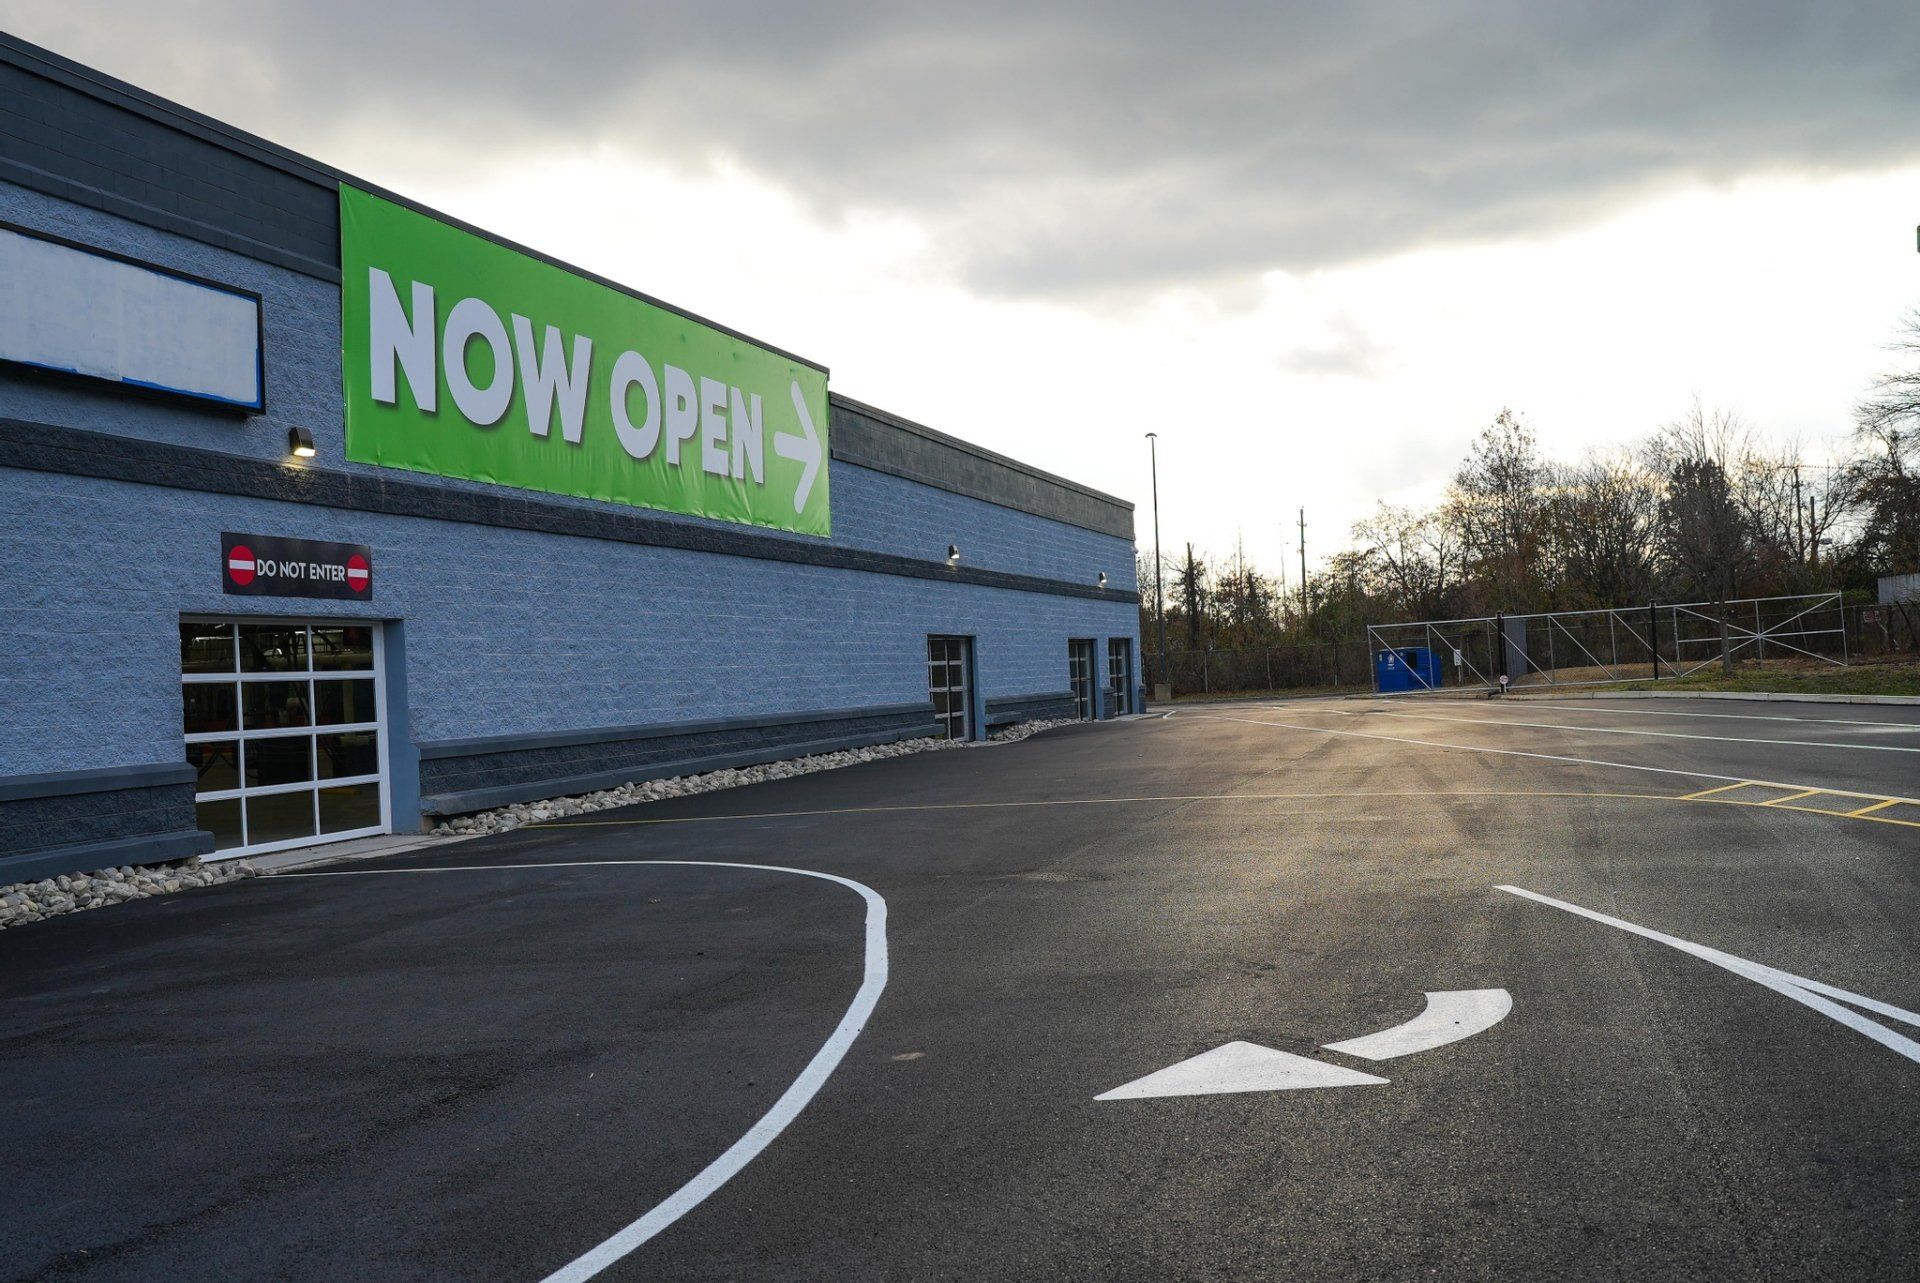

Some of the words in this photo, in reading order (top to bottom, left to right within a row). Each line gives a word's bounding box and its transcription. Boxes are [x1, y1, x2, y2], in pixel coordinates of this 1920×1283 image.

[368, 266, 593, 444] NOW
[610, 350, 764, 484] OPEN
[257, 559, 277, 577] DO
[280, 561, 307, 579] NOT
[309, 564, 345, 582] ENTER
